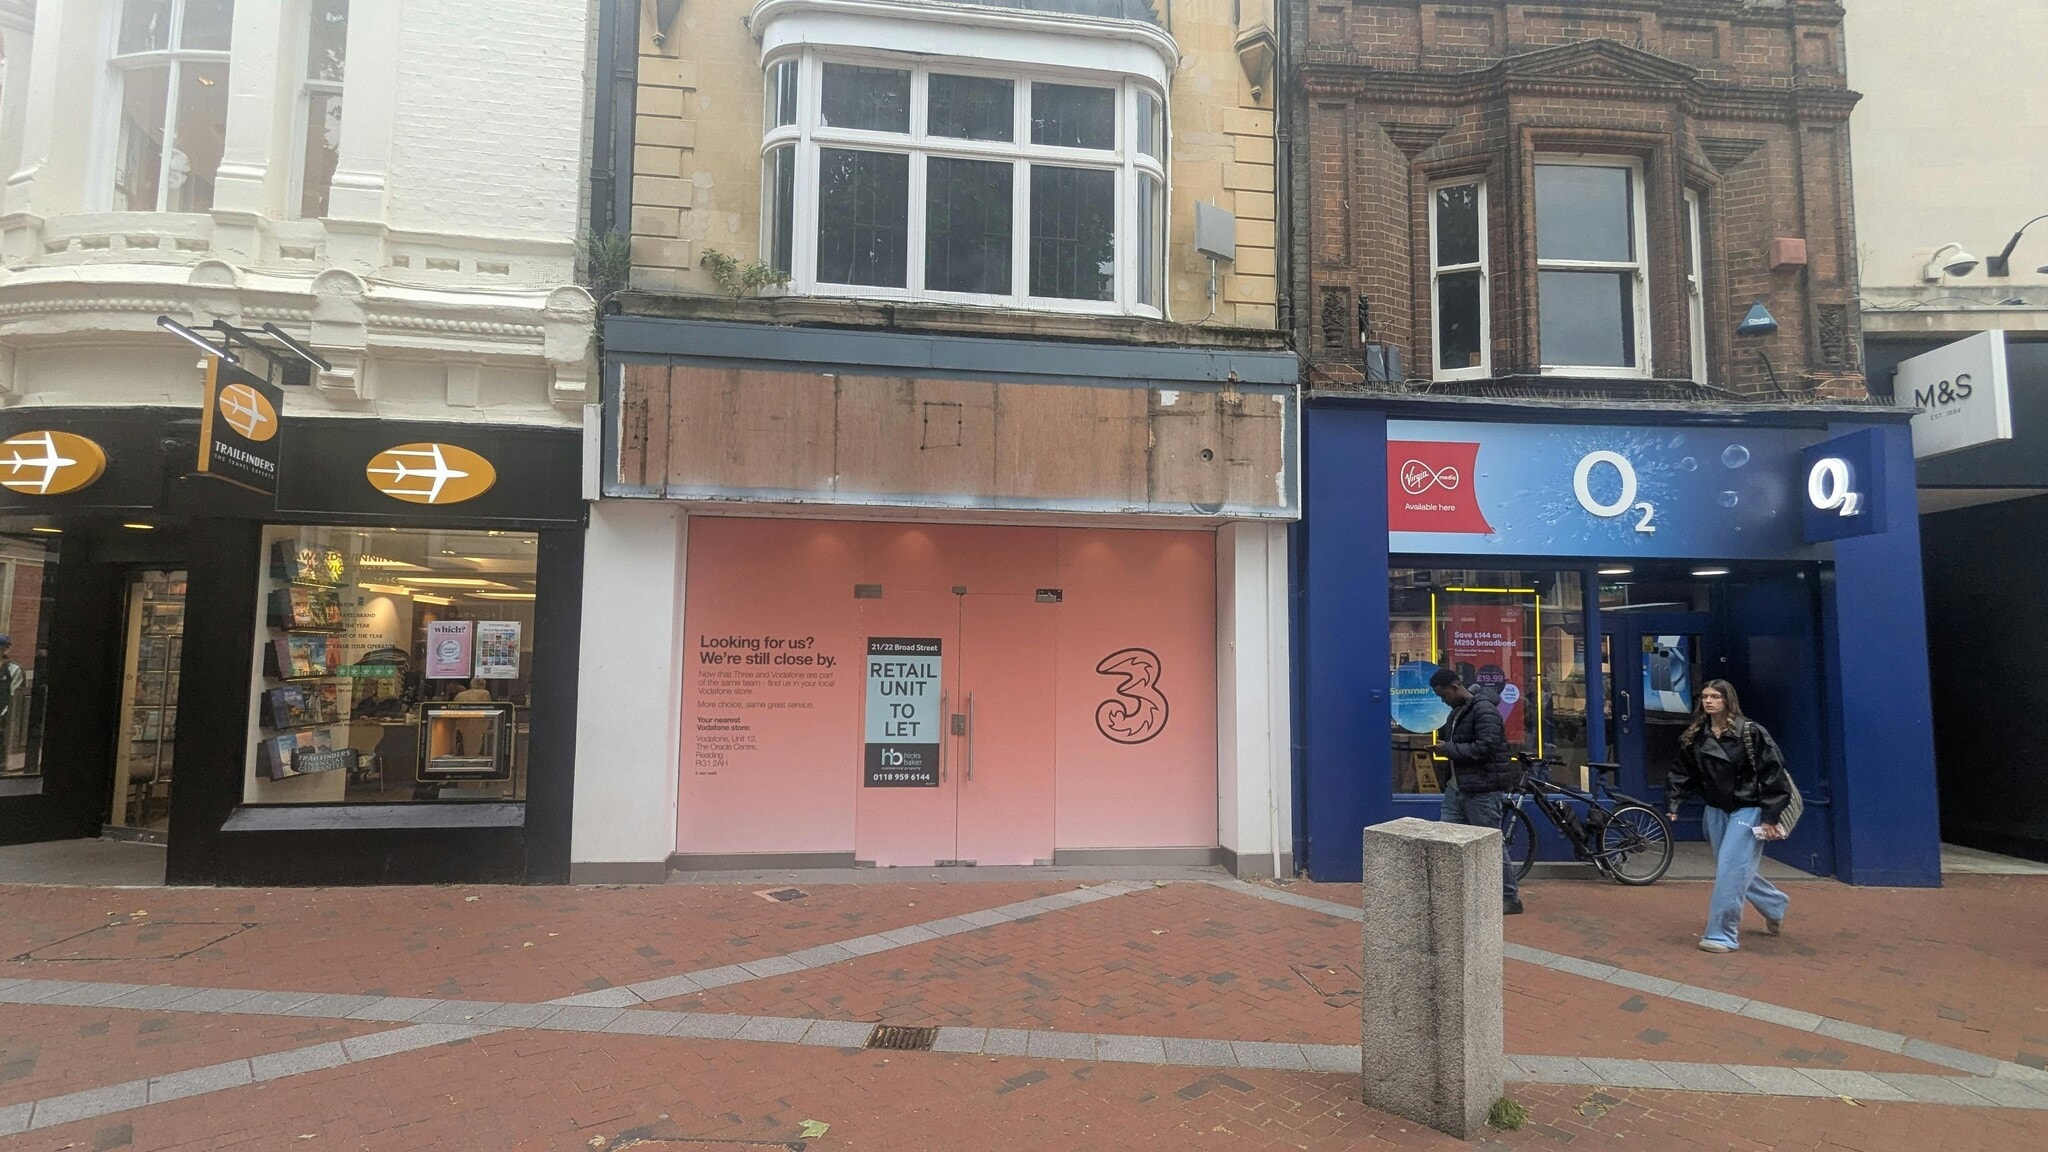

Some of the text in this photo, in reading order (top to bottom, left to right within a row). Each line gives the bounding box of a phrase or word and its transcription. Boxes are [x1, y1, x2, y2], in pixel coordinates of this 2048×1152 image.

[1914, 373, 1972, 409] M&S
[1930, 413, 1942, 421] EST
[215, 440, 275, 473] TRAILFINDERS
[214, 453, 274, 480] THE TRAVEL EXPERTS
[1404, 465, 1430, 488] Virgin
[1404, 503, 1456, 512] Available here
[434, 625, 466, 634] which?
[1454, 631, 1473, 639] Save
[700, 635, 815, 651] Looking for us?
[871, 643, 938, 652] 21/22 Broad Street
[745, 652, 770, 665] still
[773, 653, 813, 665] close
[817, 653, 837, 668] by.
[870, 662, 938, 678] RETAIL
[698, 670, 716, 678] Now
[717, 670, 732, 678] that
[734, 670, 754, 678] Three
[771, 671, 805, 679] Vodafone
[819, 672, 834, 680] part
[1477, 674, 1504, 683] £19.99
[767, 679, 781, 687] find
[698, 687, 733, 695] Vodafone
[880, 680, 927, 696] UNIT
[1390, 687, 1429, 696] Summer
[718, 701, 744, 709] choice,
[889, 703, 915, 719] TO
[885, 721, 921, 737] LET
[696, 735, 731, 743] Vodafone,
[733, 743, 758, 751] Centre,
[298, 750, 351, 762] TRAILFINDERS
[695, 752, 724, 760] Reading
[873, 773, 930, 781] 0118 959 6144
